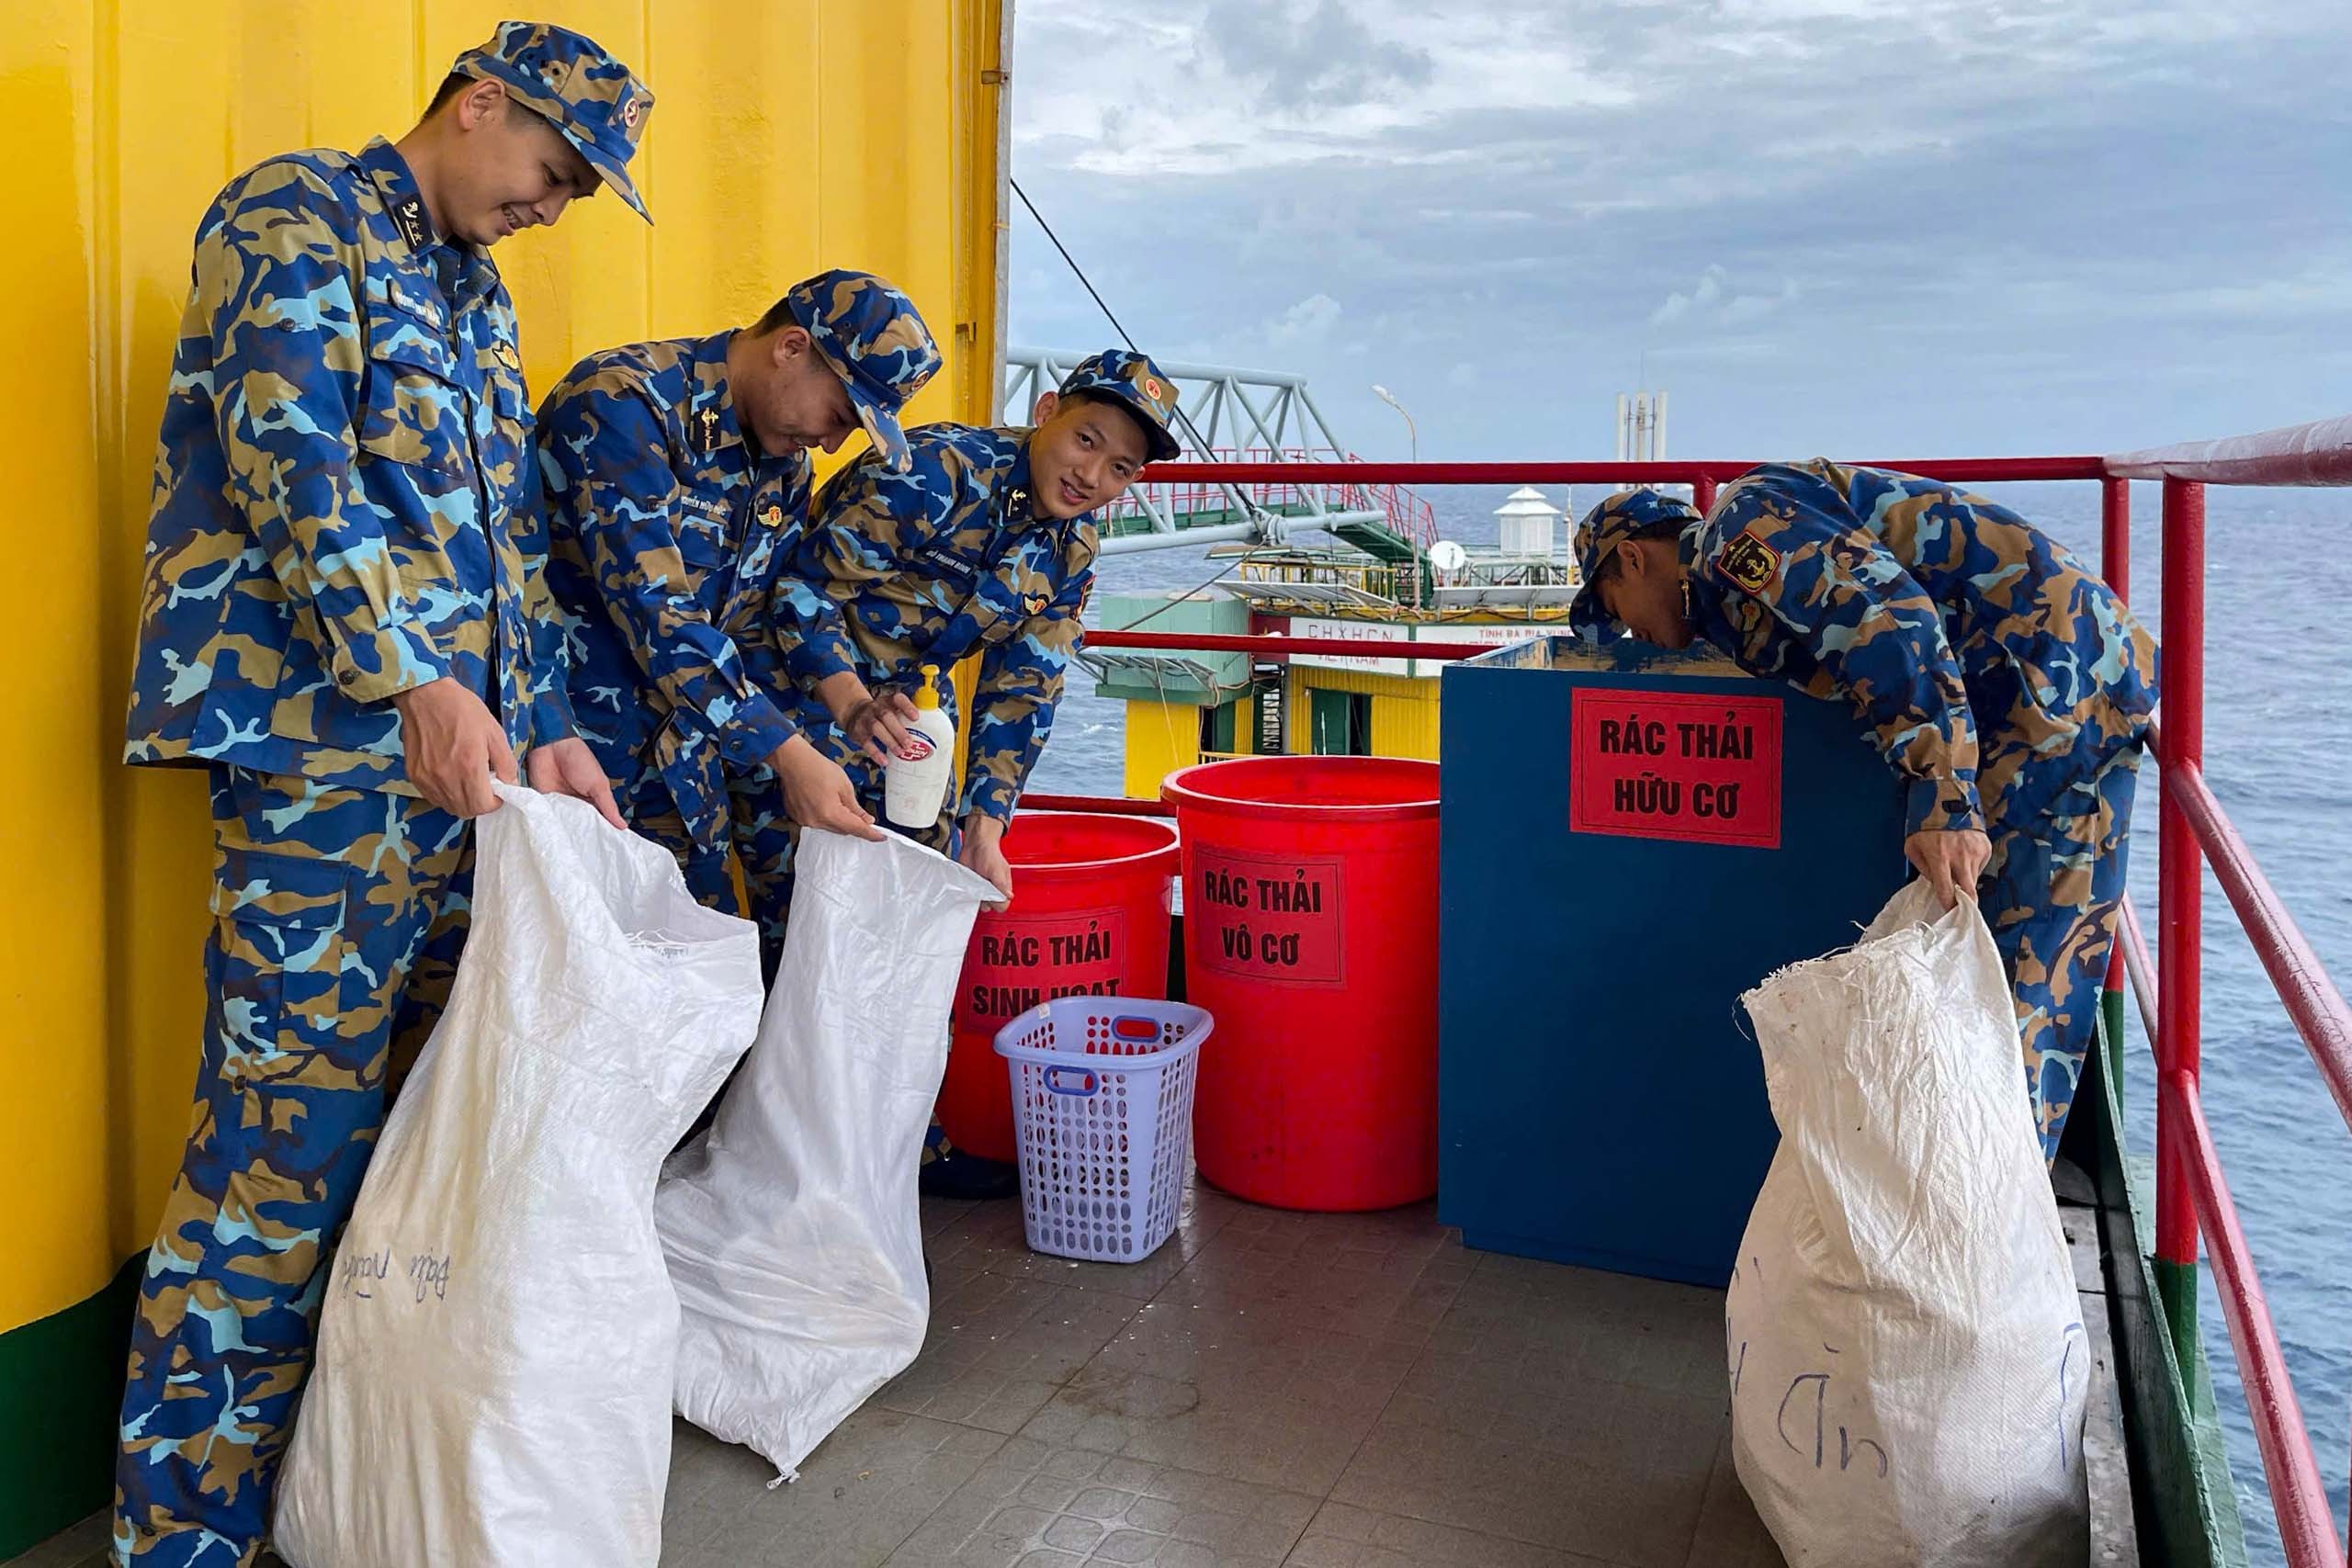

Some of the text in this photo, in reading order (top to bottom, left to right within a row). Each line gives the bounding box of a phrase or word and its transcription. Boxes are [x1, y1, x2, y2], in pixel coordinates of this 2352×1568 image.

[1600, 710, 1754, 761] RÁC THẢI
[1614, 772, 1740, 819] HỮU CƠ
[1204, 867, 1321, 913] RÁC THẢI
[981, 920, 1111, 967] RÁC THẢI
[1221, 923, 1300, 966] VÔ CƠ
[972, 984, 1040, 1018] SINH
